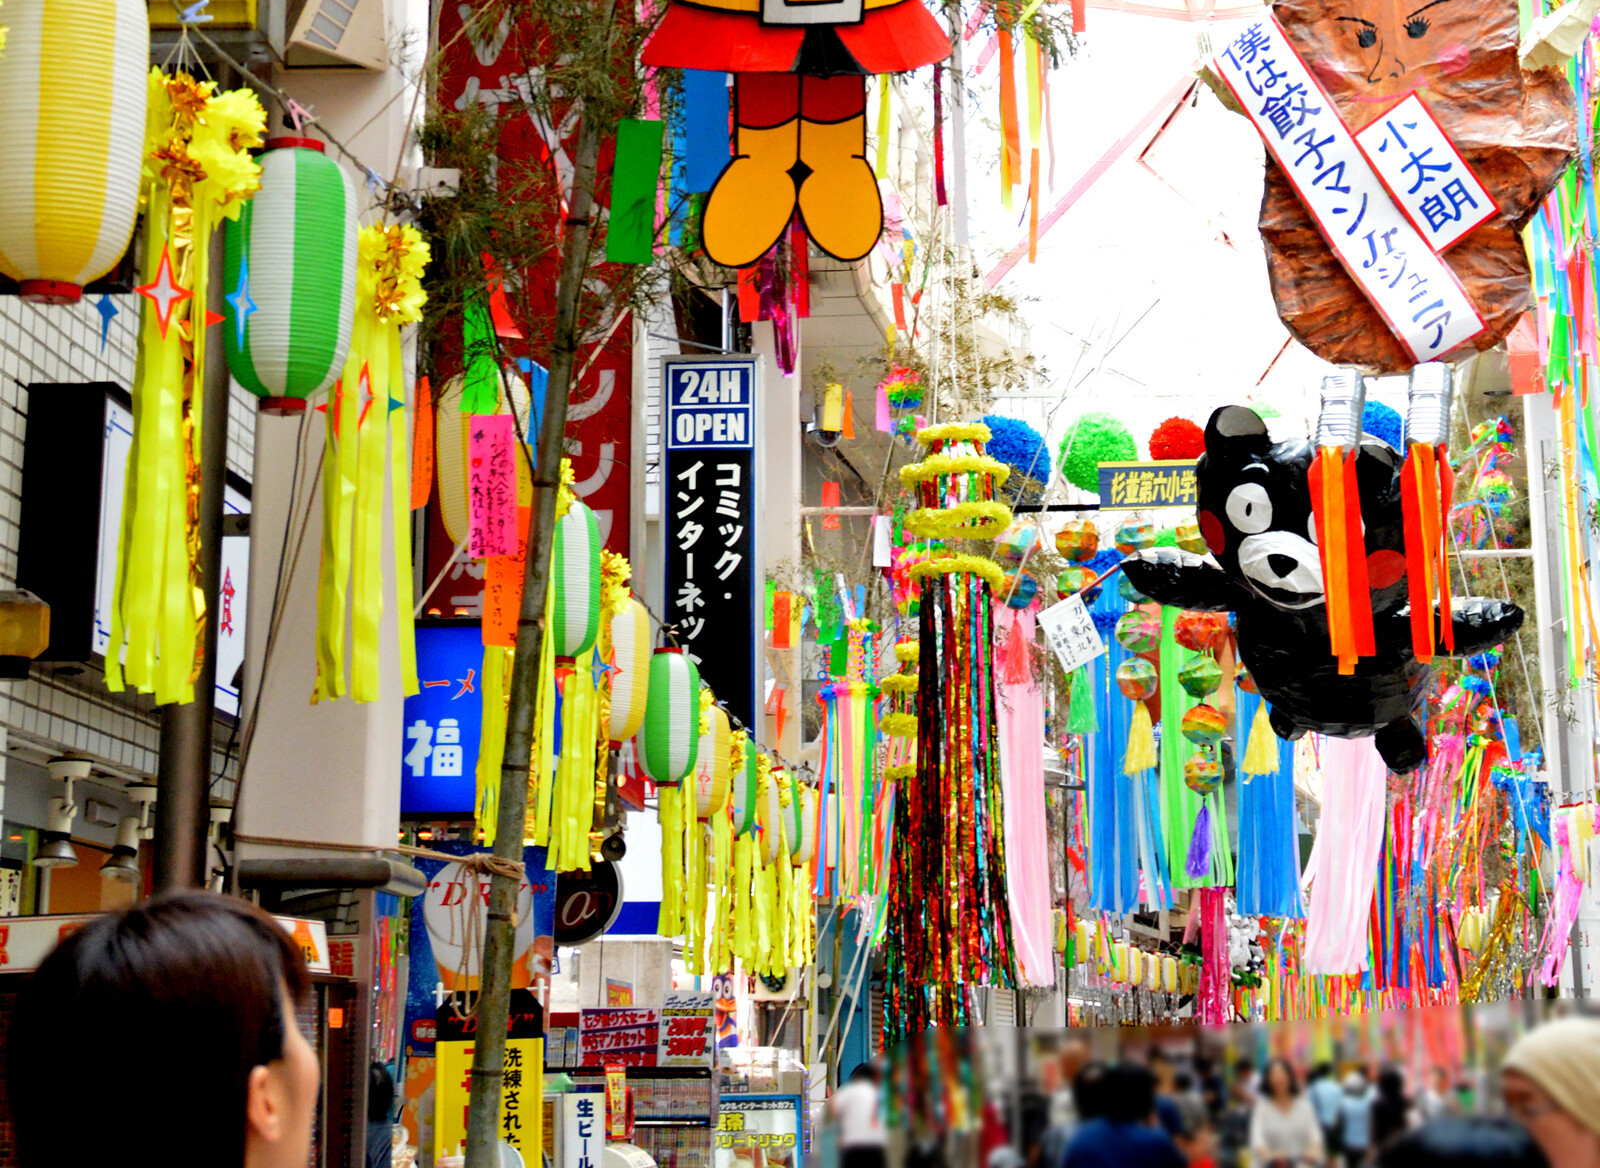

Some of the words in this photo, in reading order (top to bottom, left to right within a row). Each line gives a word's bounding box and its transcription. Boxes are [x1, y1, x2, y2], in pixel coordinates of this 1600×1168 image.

[1377, 118, 1479, 233] 小太朗
[679, 370, 742, 404] 24H
[676, 412, 745, 443] OPEN
[1111, 469, 1198, 505] 杉並第六小学
[675, 460, 706, 666] インターネット
[403, 718, 463, 777] 福
